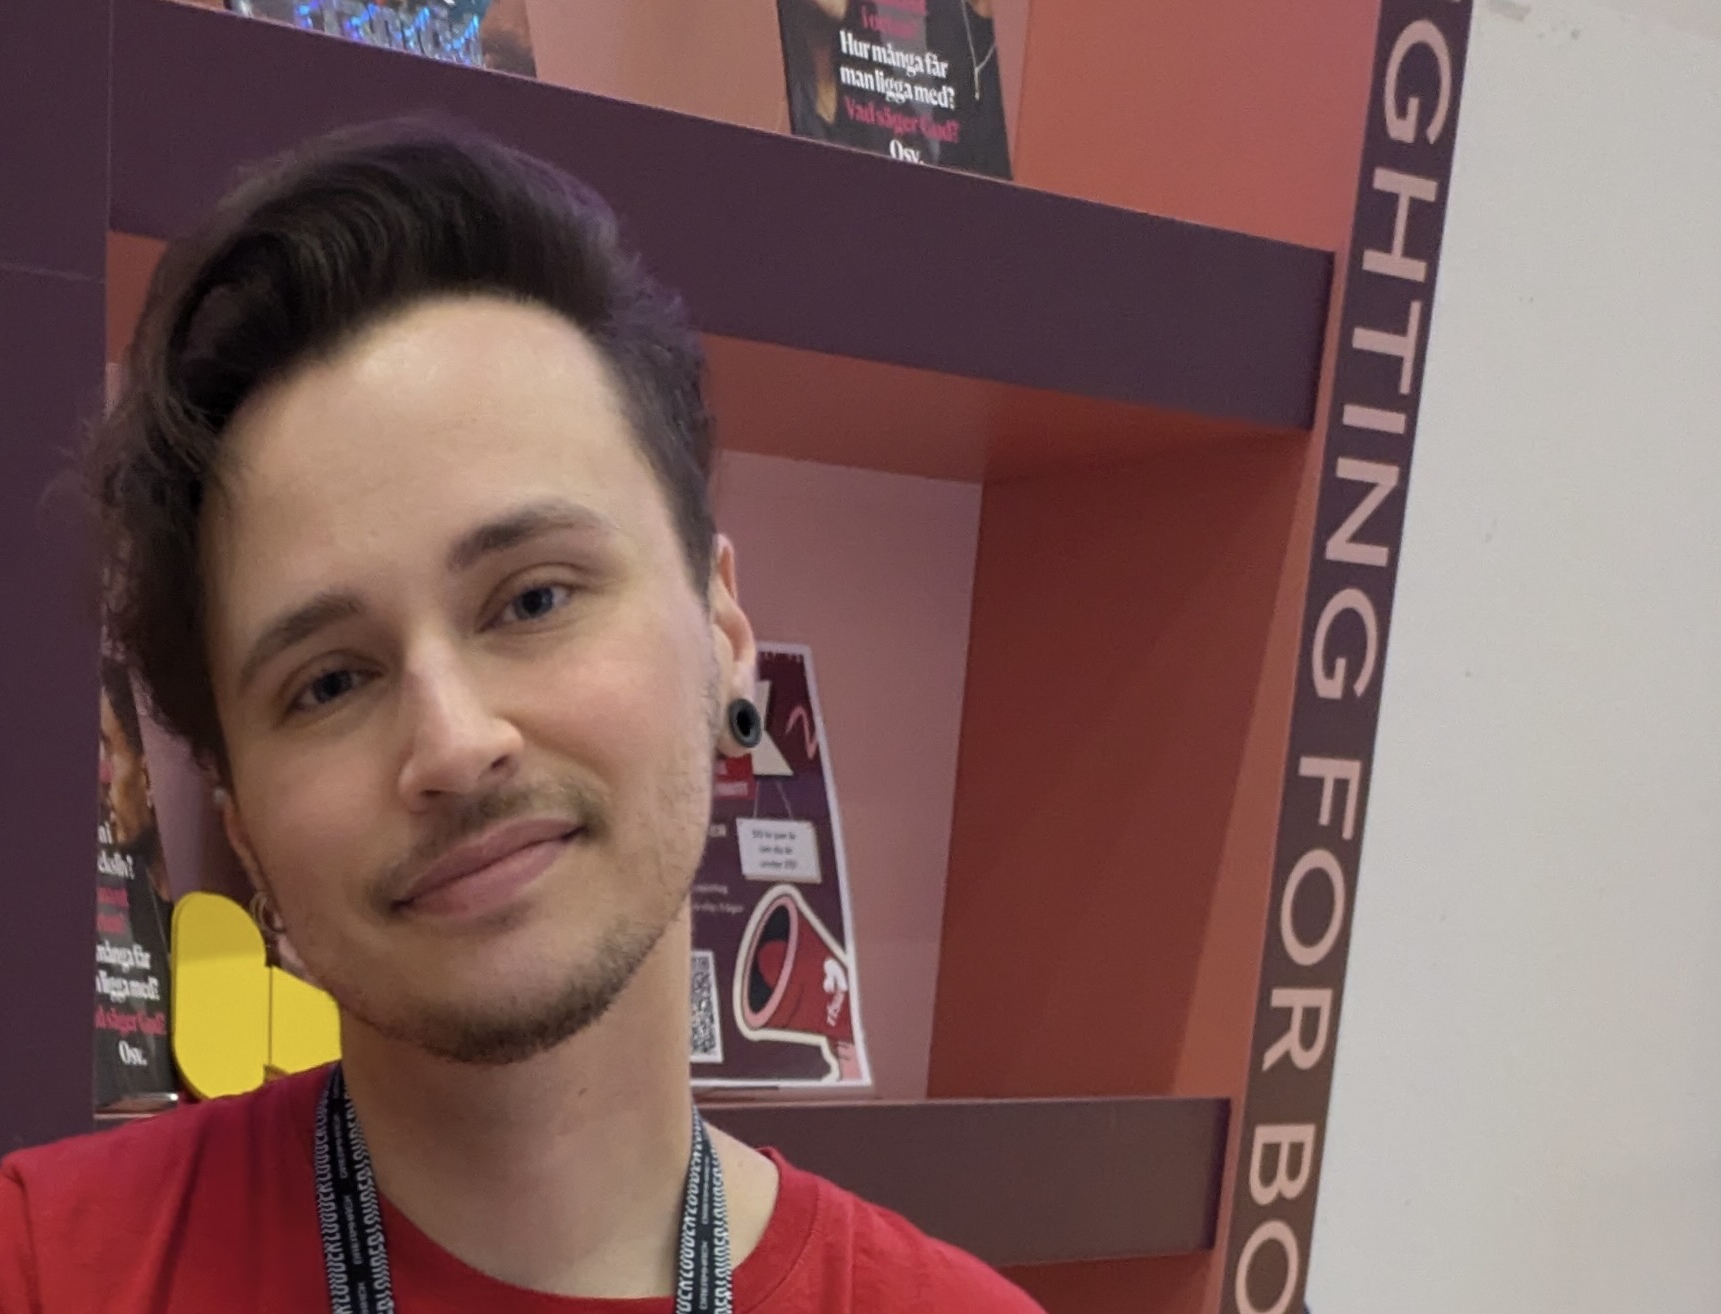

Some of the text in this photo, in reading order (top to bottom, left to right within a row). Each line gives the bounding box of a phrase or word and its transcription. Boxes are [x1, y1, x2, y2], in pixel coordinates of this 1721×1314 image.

[839, 29, 949, 79] Hur många får
[839, 65, 956, 111] man ligga med?
[1312, 20, 1453, 699] GHTING
[1261, 756, 1362, 1073] FOR
